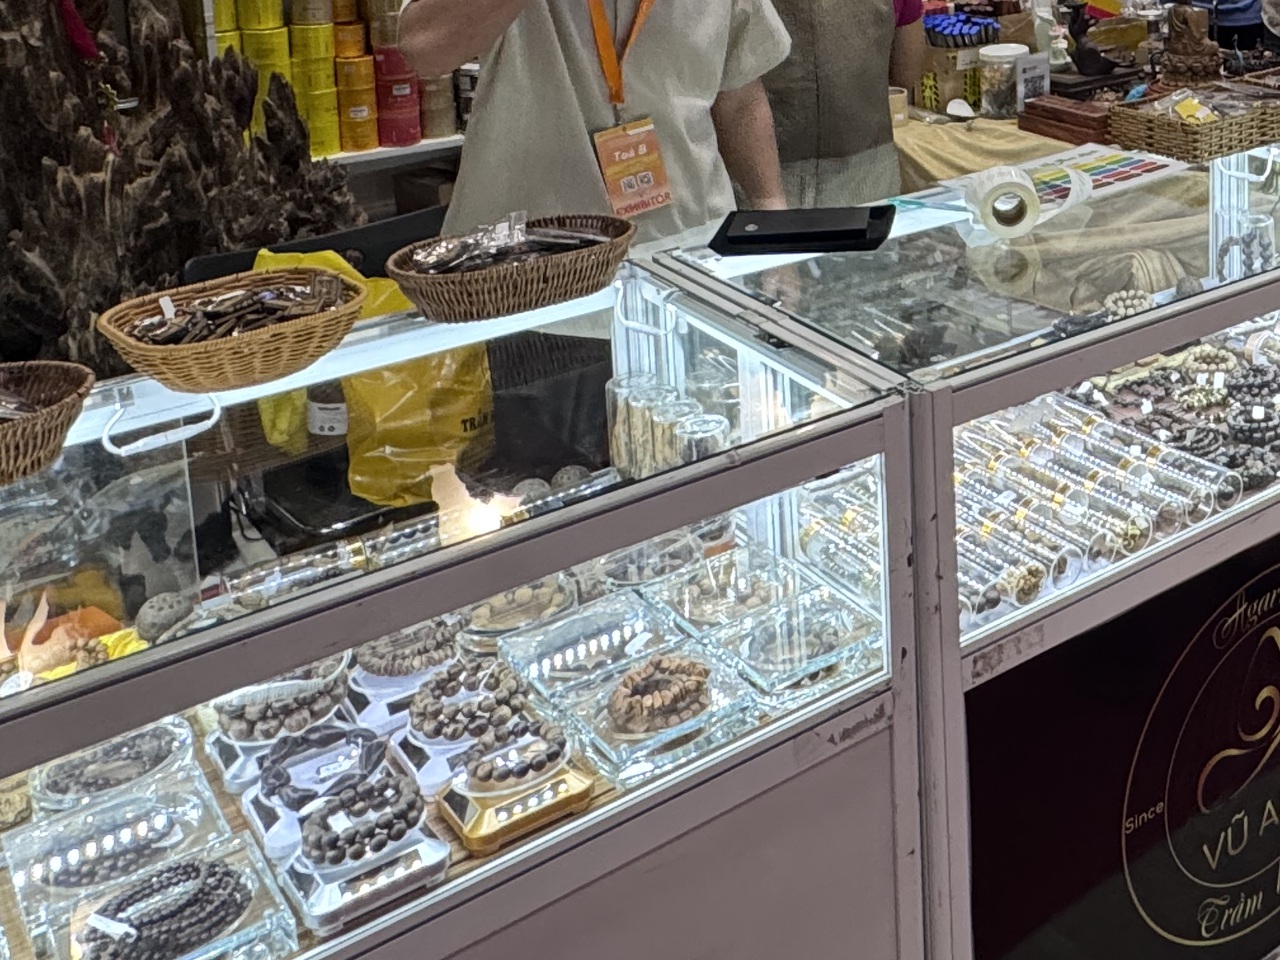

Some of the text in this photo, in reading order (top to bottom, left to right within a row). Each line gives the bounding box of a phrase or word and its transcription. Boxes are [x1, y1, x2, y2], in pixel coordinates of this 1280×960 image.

[616, 192, 672, 216] EXHIBITOR
[1124, 801, 1165, 835] Since
[1202, 811, 1250, 871] VŨ
